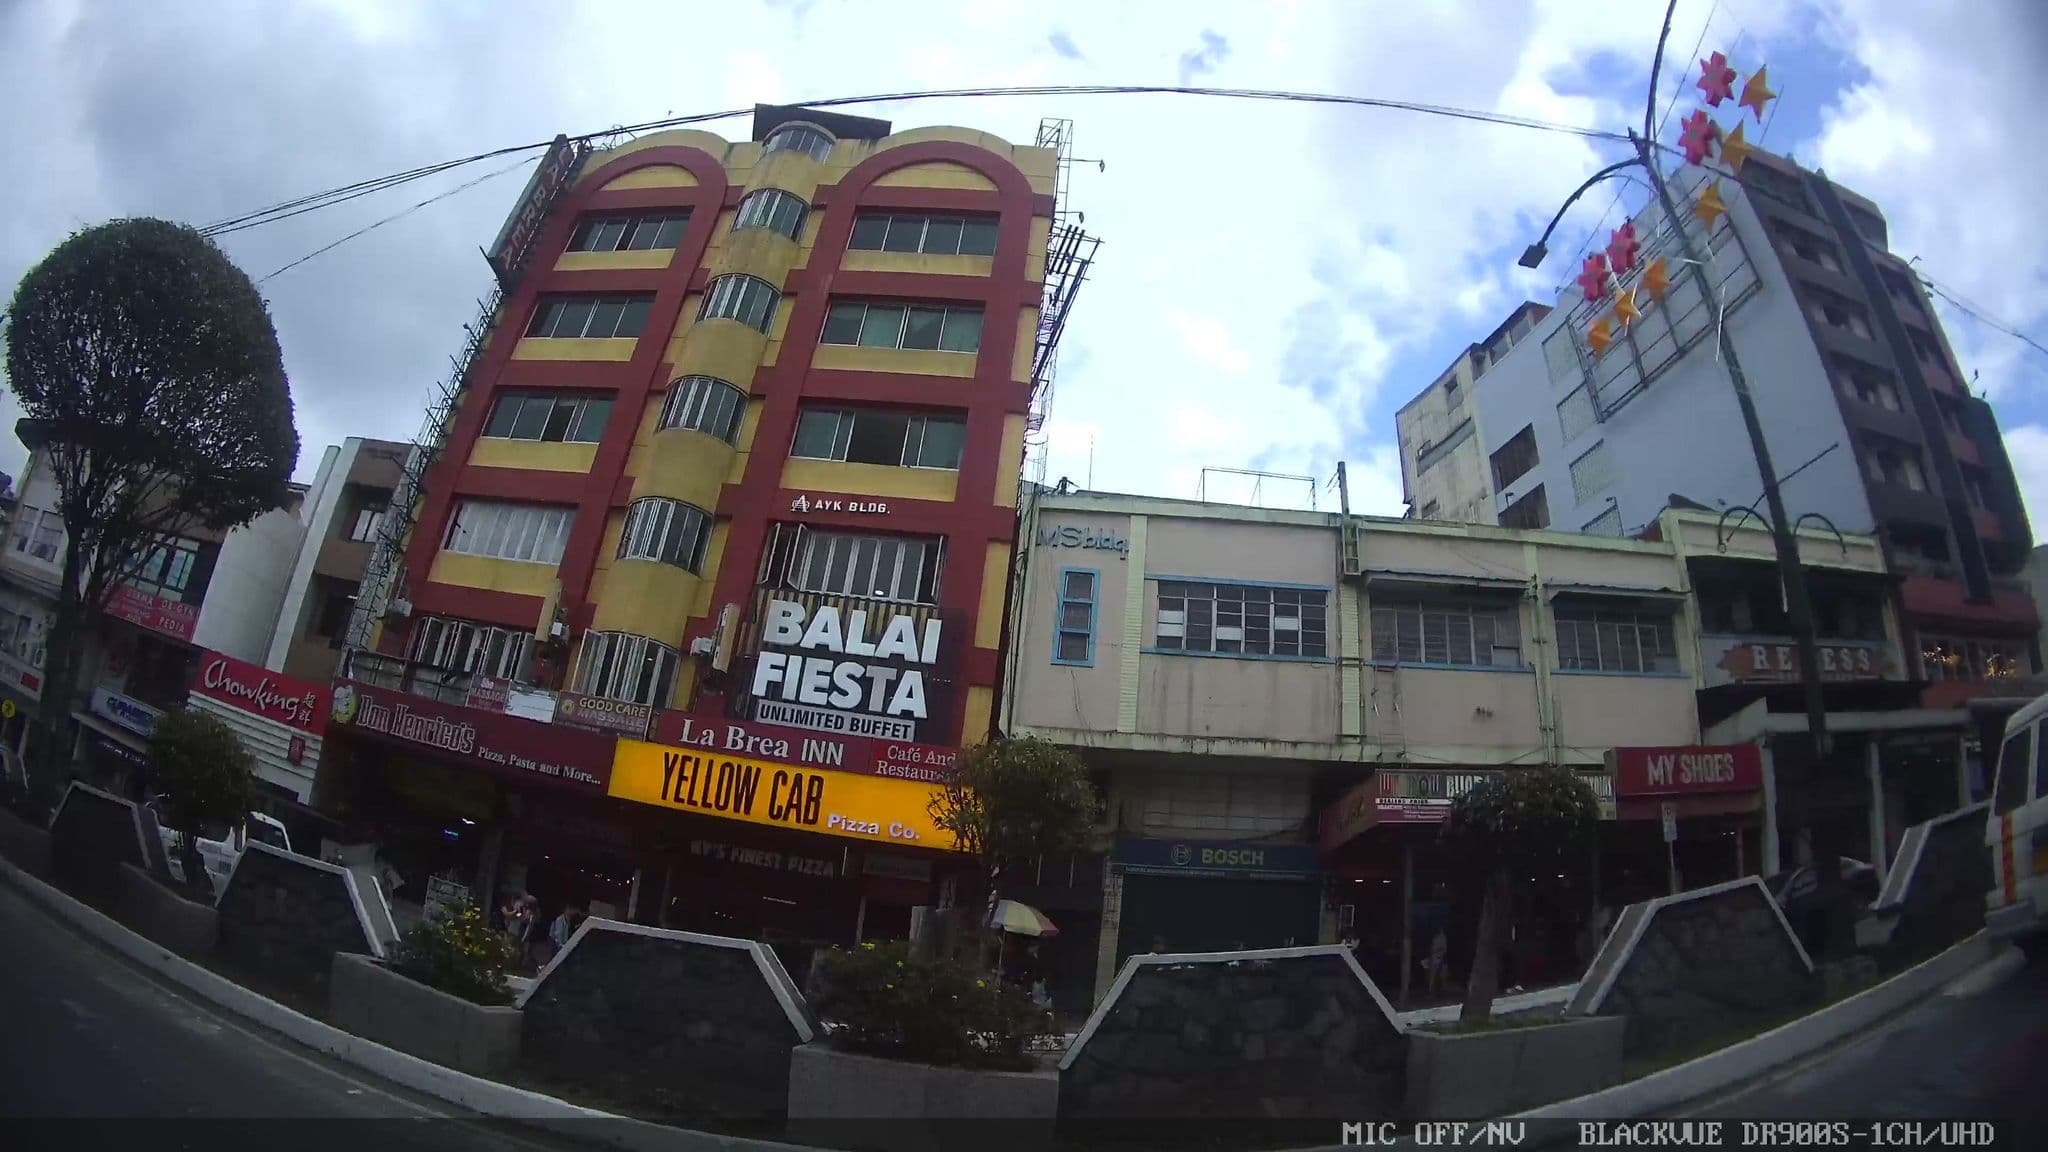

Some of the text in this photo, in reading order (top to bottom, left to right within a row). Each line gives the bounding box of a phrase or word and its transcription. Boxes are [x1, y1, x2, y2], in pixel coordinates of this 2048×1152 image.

[815, 499, 842, 512] AYK
[848, 501, 891, 514] BLDG.
[763, 599, 942, 665] BALAI
[1751, 645, 1872, 673] REESS
[204, 659, 301, 720] Chowking
[751, 651, 928, 719] FIESTA
[577, 709, 645, 729] MASSAGE
[579, 697, 647, 718] GOOD CARE
[759, 704, 912, 740] UNLIMITED BUFFET
[356, 694, 476, 755] Don Henrico's
[680, 719, 844, 765] La Brea INN
[888, 745, 957, 766] Café And
[478, 747, 602, 785] Pizza, Pasta and More...
[876, 760, 953, 781] Restaur
[1648, 753, 1734, 784] MY SHOES
[661, 751, 825, 826] YELLOW CAB
[827, 814, 920, 840] Pizza Co.
[730, 847, 783, 871] FINEST
[787, 855, 835, 880] PIZZA
[1201, 847, 1265, 866] BOSCH
